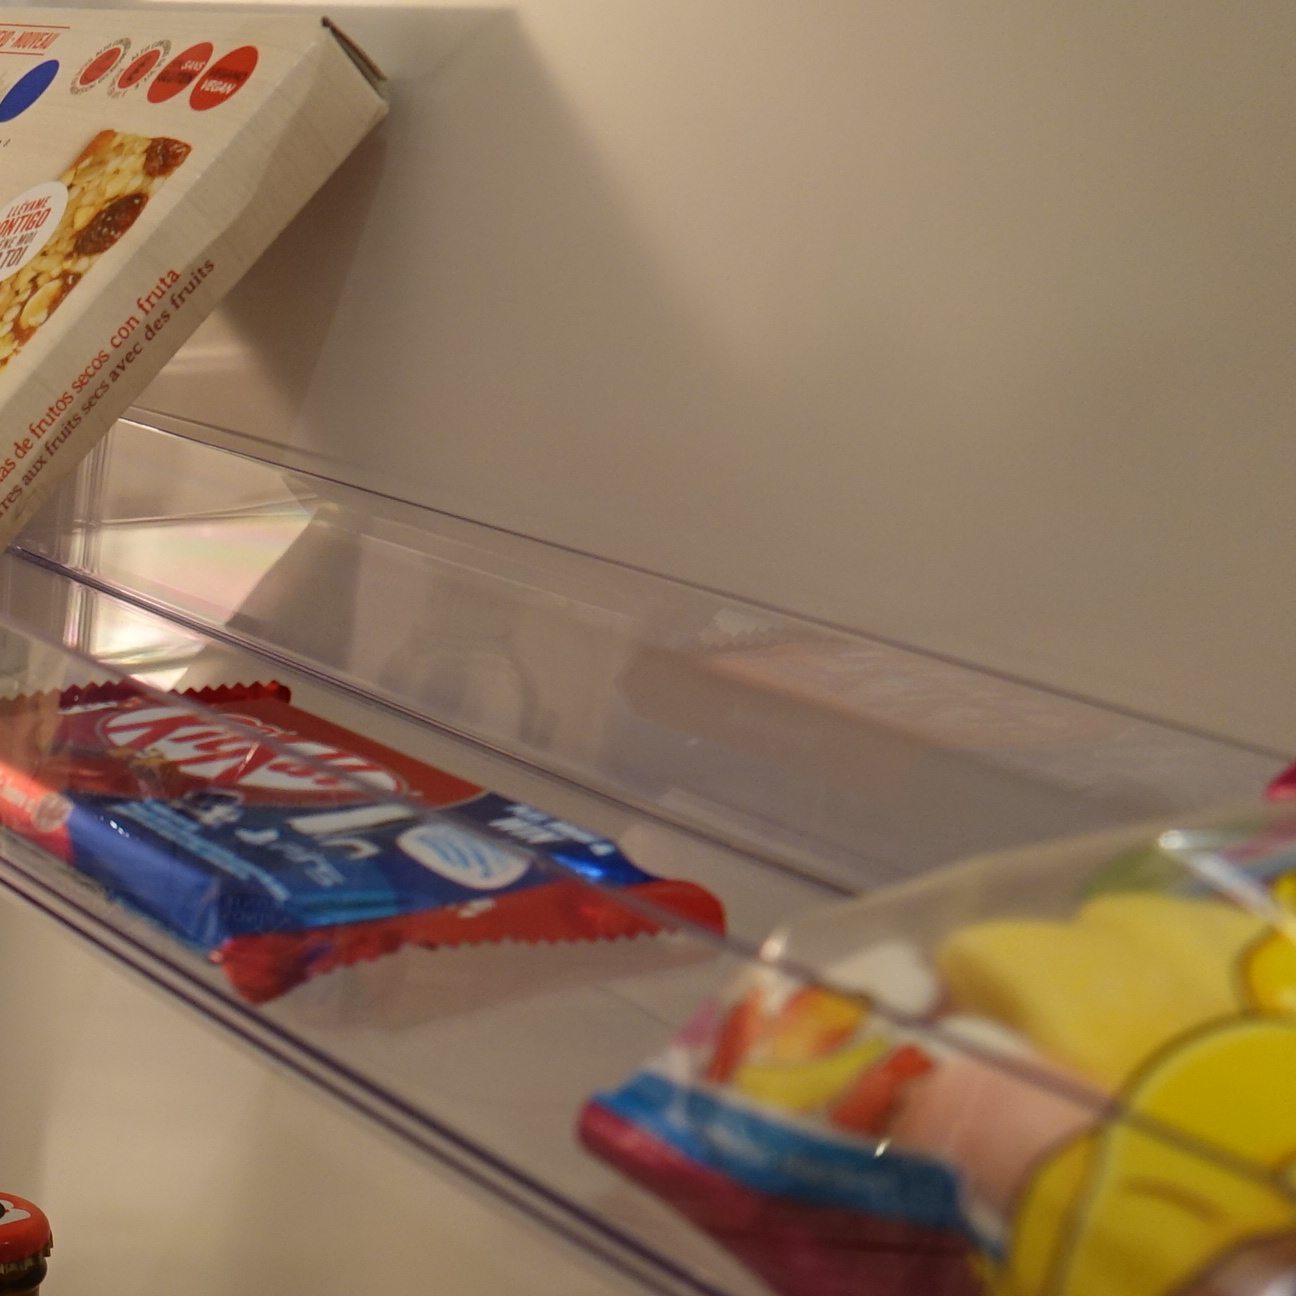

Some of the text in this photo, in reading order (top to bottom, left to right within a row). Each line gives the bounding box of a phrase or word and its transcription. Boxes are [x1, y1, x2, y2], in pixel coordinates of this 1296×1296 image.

[201, 79, 237, 95] VEGAN
[16, 230, 38, 246] MOI
[0, 244, 29, 270] TOI
[13, 436, 34, 462] de
[28, 391, 76, 438] frutos
[70, 349, 111, 395] secos
[110, 315, 140, 349] con
[136, 268, 182, 317] fruta
[21, 455, 48, 488] aux
[45, 411, 84, 457] fruits
[81, 385, 111, 415] secs
[109, 344, 143, 384] avec
[143, 312, 171, 344] des
[170, 257, 215, 314] fruits
